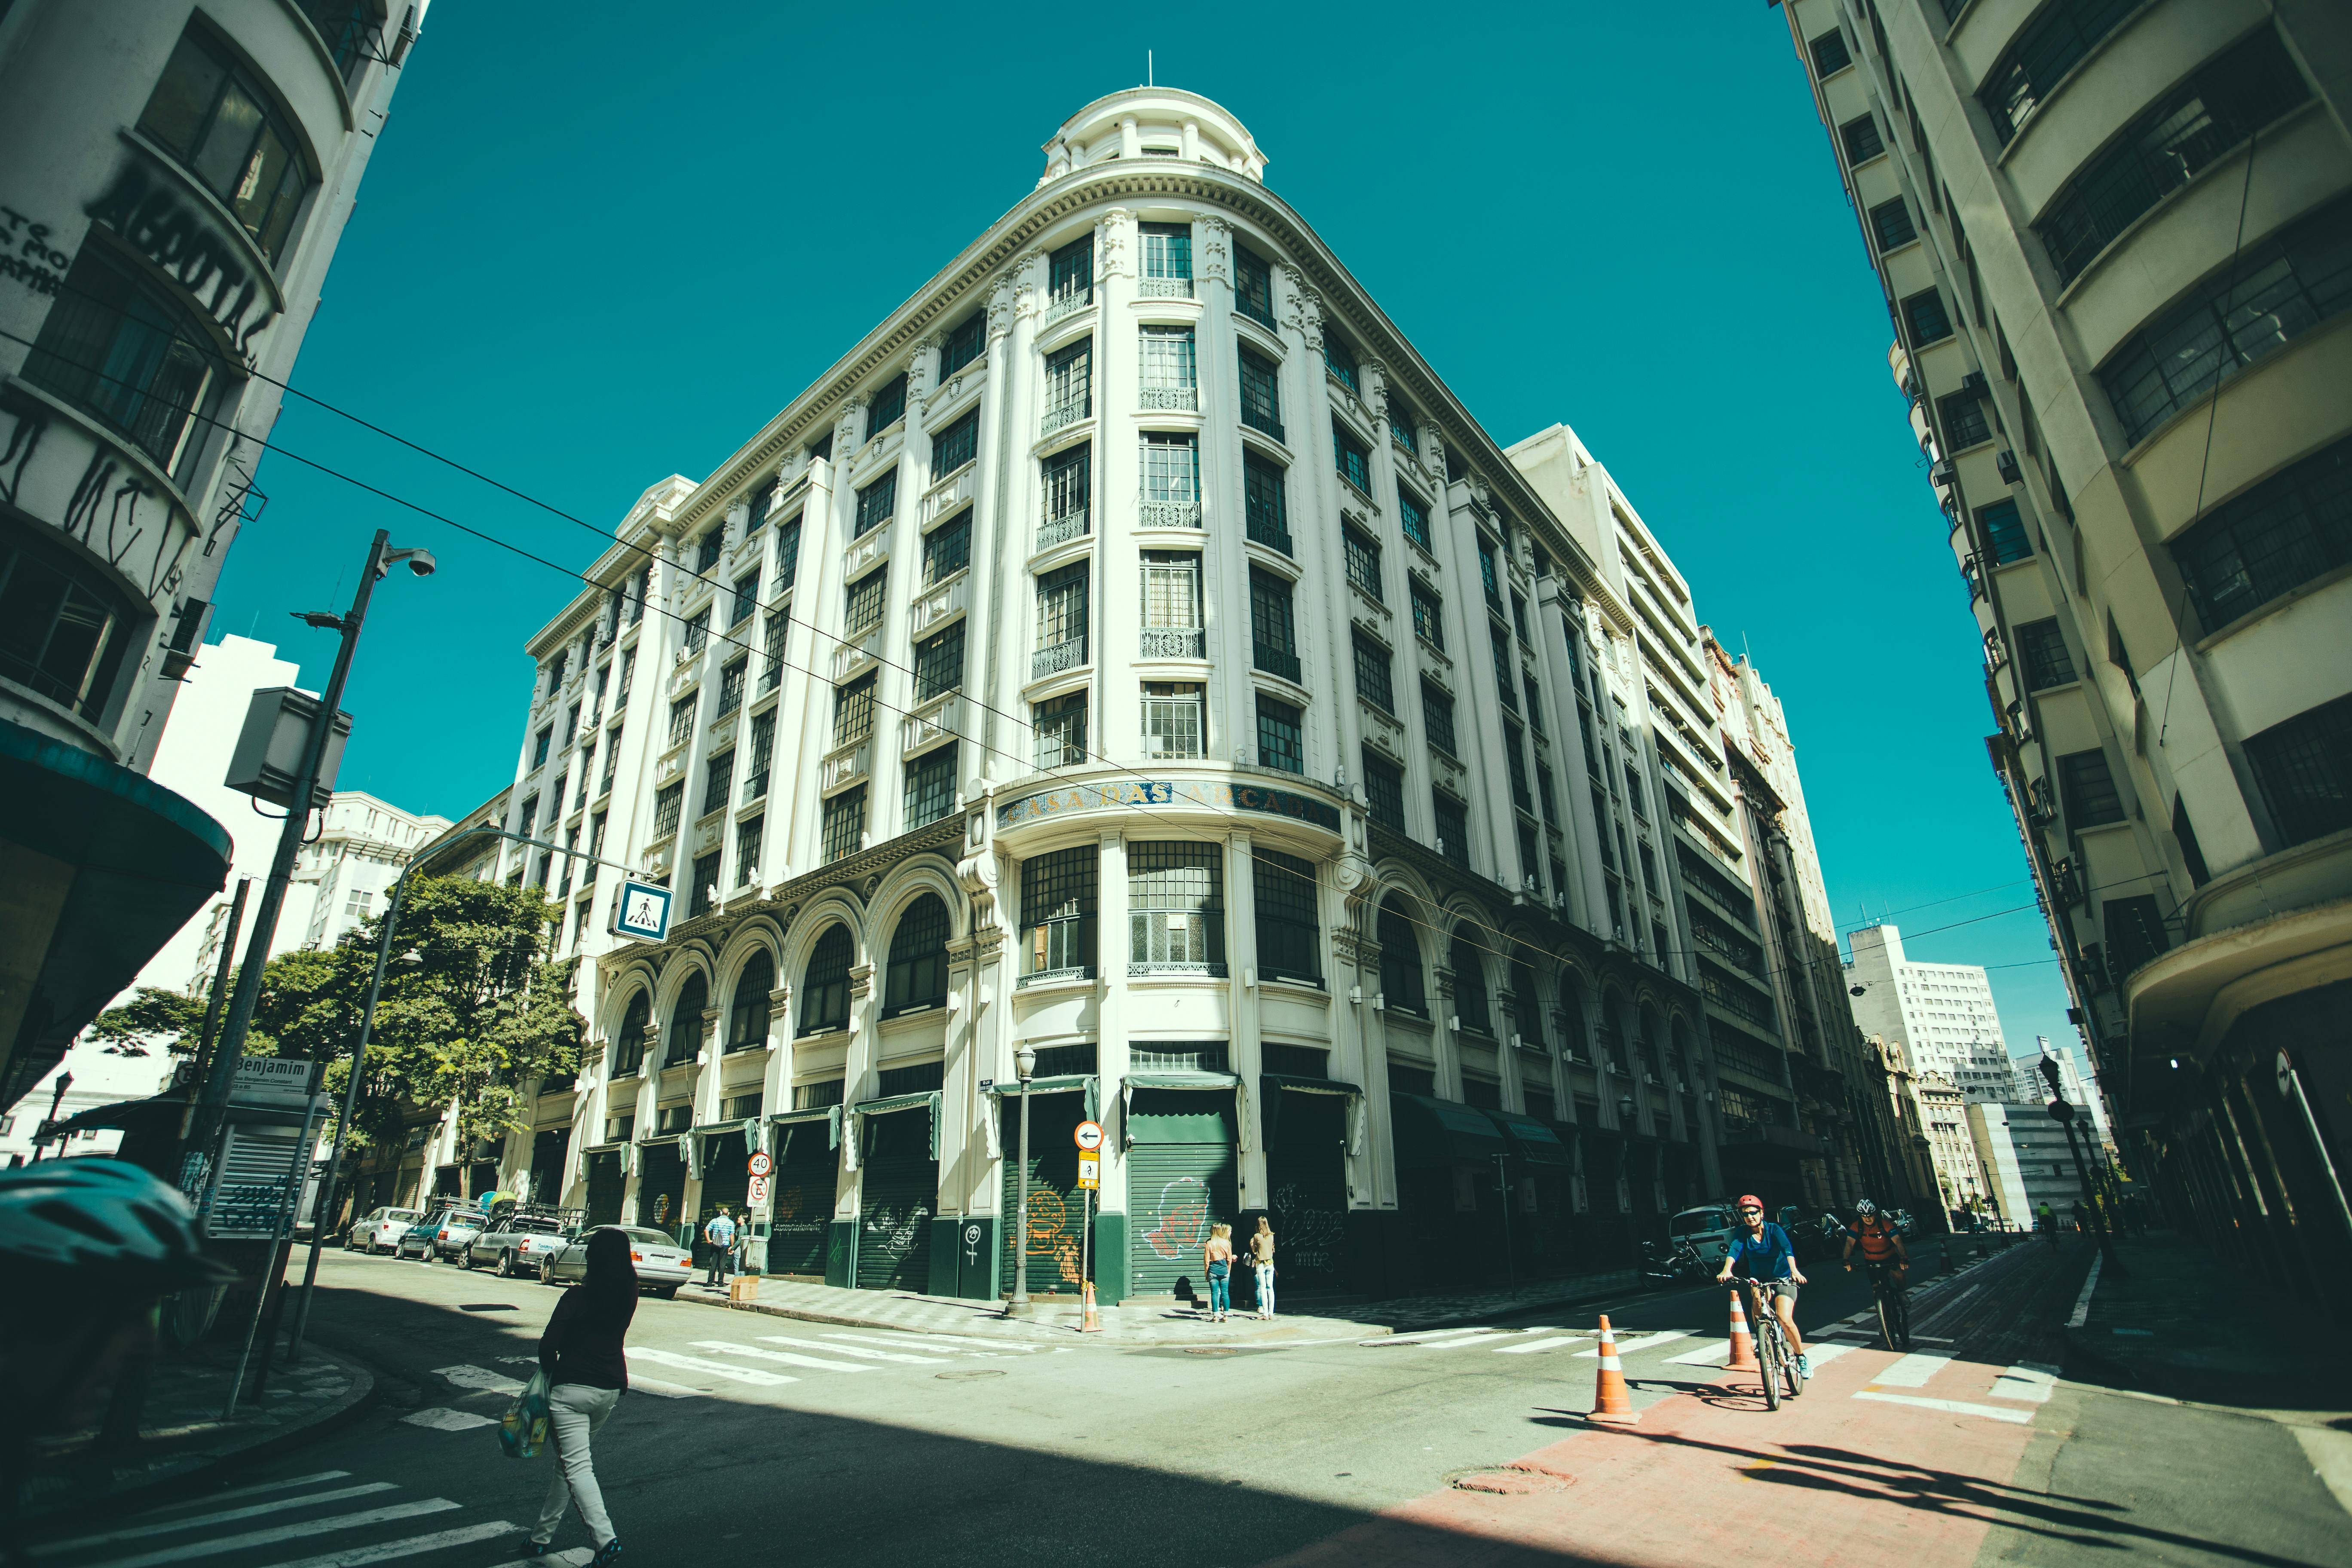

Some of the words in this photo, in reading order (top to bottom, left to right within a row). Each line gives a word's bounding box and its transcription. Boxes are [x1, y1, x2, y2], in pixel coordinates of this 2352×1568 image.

[1008, 791, 1084, 822] CASA
[1099, 783, 1168, 805] DAS
[237, 1057, 305, 1075] Benjamim
[753, 1158, 767, 1168] 40
